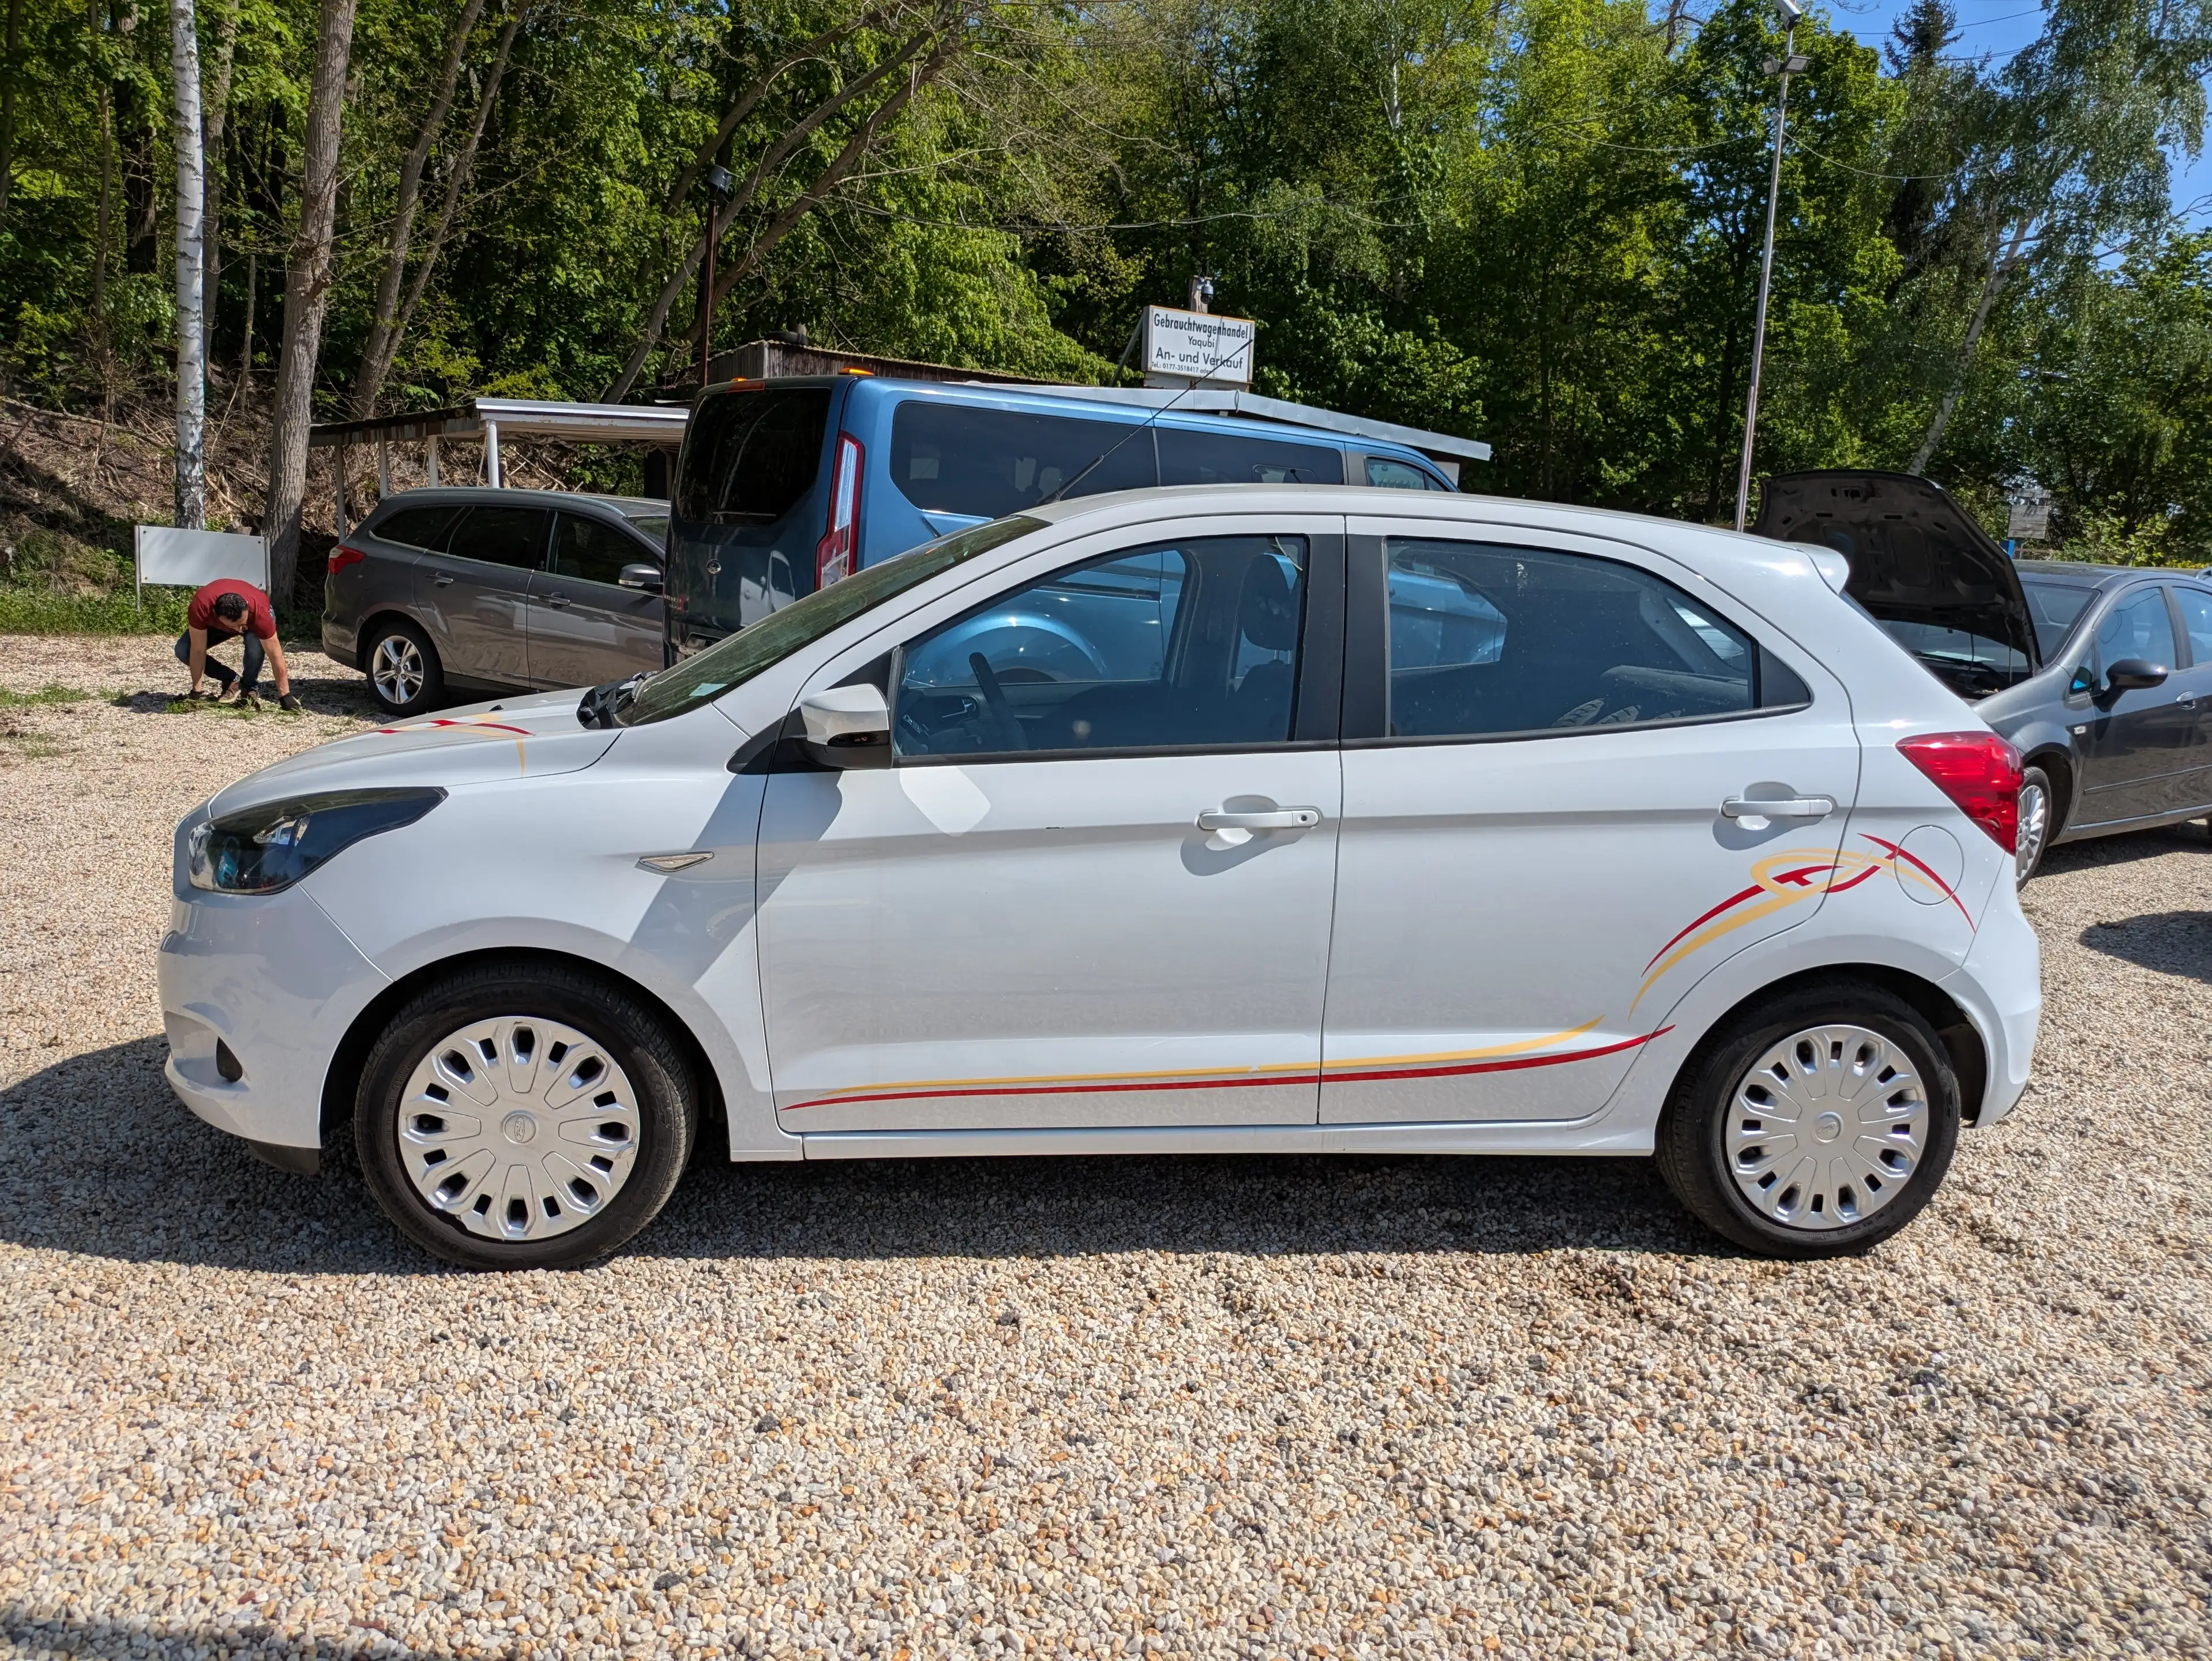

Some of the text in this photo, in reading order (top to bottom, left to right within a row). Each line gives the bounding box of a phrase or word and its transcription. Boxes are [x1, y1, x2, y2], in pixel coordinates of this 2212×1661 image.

[1154, 313, 1248, 339] Gebrauchtwagenhandel
[1188, 336, 1215, 348] Yaqubi
[1155, 347, 1244, 369] An- und Verkauf
[1162, 363, 1199, 373] 0177-3518417
